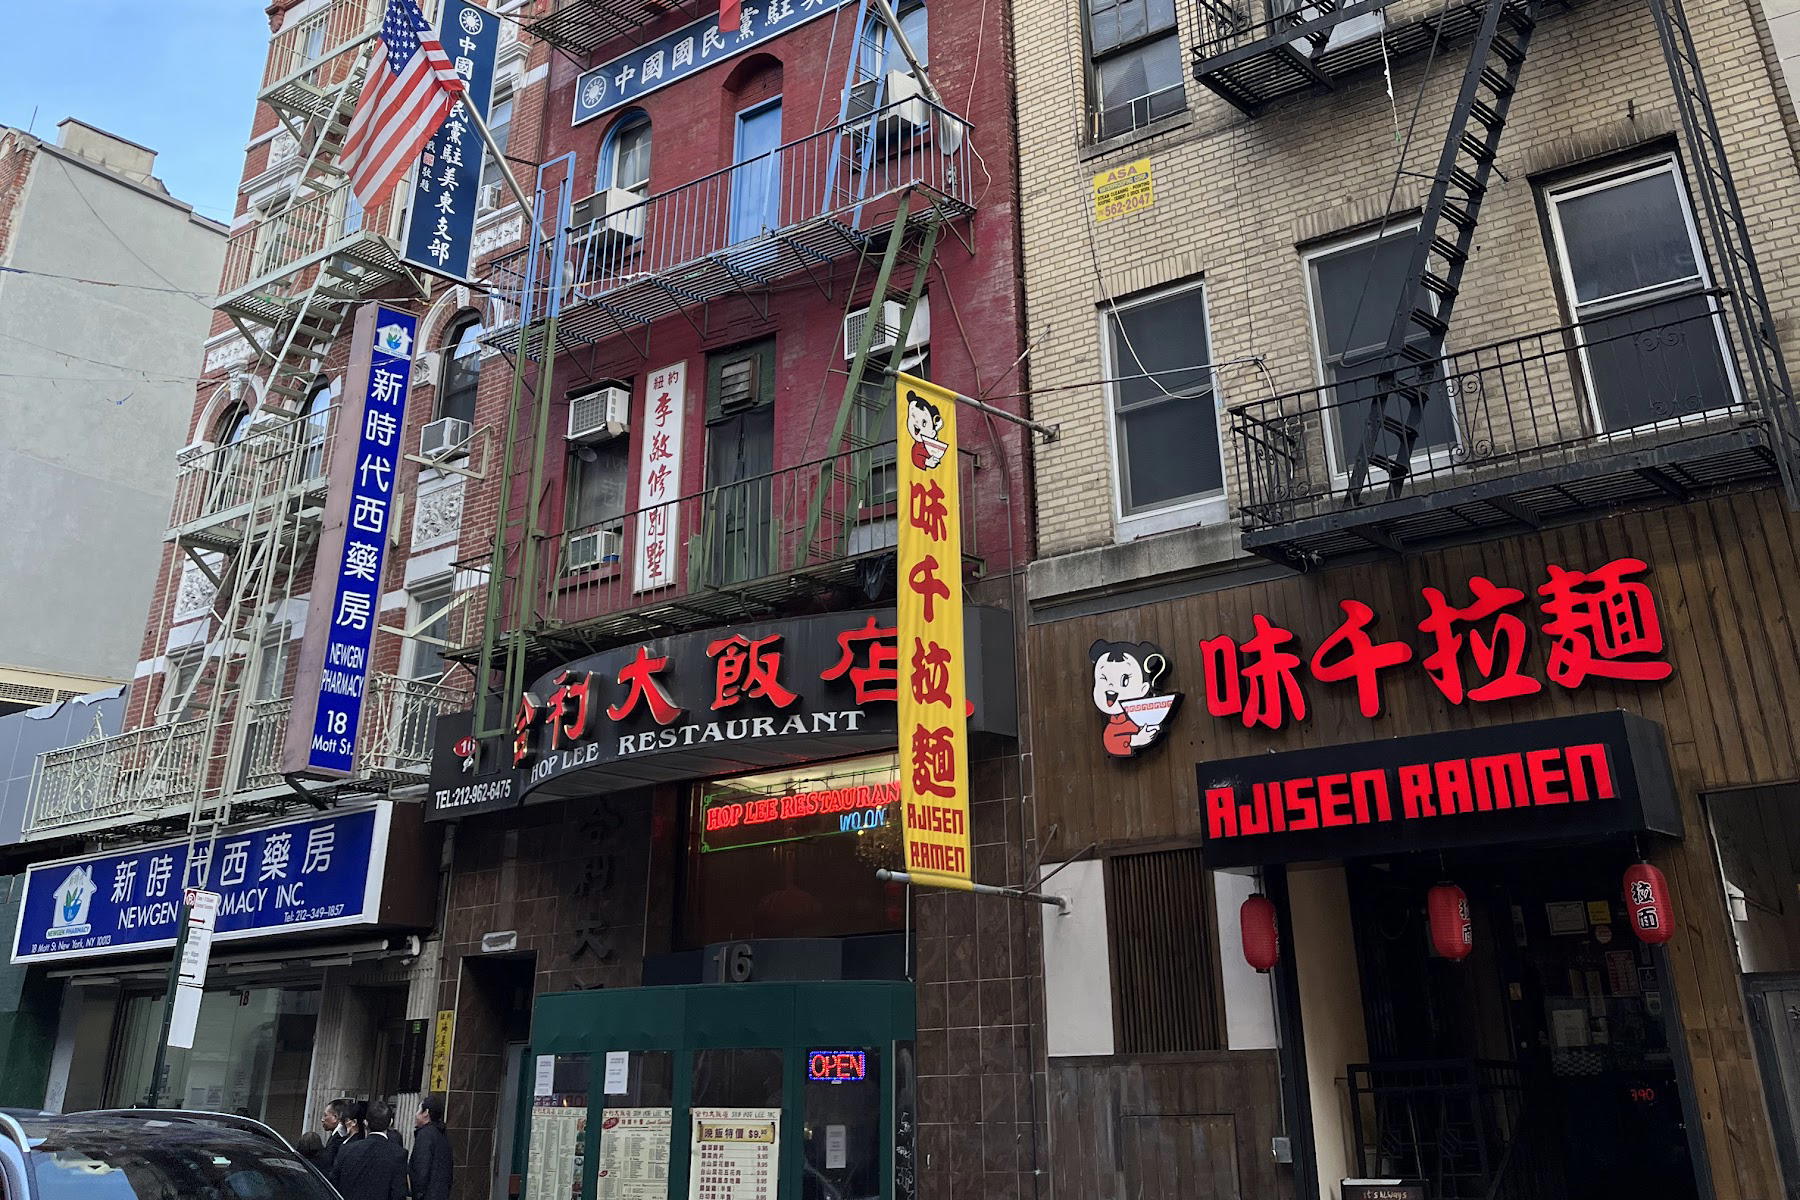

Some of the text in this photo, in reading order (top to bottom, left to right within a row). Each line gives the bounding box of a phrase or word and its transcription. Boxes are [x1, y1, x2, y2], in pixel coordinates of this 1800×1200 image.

[1107, 166, 1137, 182] ASA
[653, 371, 679, 390] 紐約
[336, 368, 403, 630] 新時代西藥房
[329, 642, 365, 669] NEWGEN
[320, 669, 365, 697] PHARMACY
[327, 710, 348, 734] 18
[312, 734, 353, 756] Mott St.
[531, 711, 865, 783] HOP LEE RESTAURANT
[435, 778, 511, 810] TEL:212-962-6475
[706, 781, 901, 831] HOP LEE RESTAURAN
[1205, 743, 1616, 840] AJISEN RAMEN
[908, 802, 964, 836] AJISEN
[111, 824, 335, 903] 新時代西藥房
[910, 840, 965, 874] RAMEN
[117, 900, 179, 930] NEWGEN
[275, 882, 305, 909] INC.
[284, 904, 344, 923] Tel: 212-349-1857
[1631, 881, 1659, 930] 拉面
[31, 944, 38, 953] 18
[58, 941, 70, 950] New
[85, 937, 96, 946] NY
[96, 935, 112, 946] 10013
[713, 943, 752, 984] 16
[239, 991, 250, 1006] 18
[811, 1054, 863, 1078] OPEN
